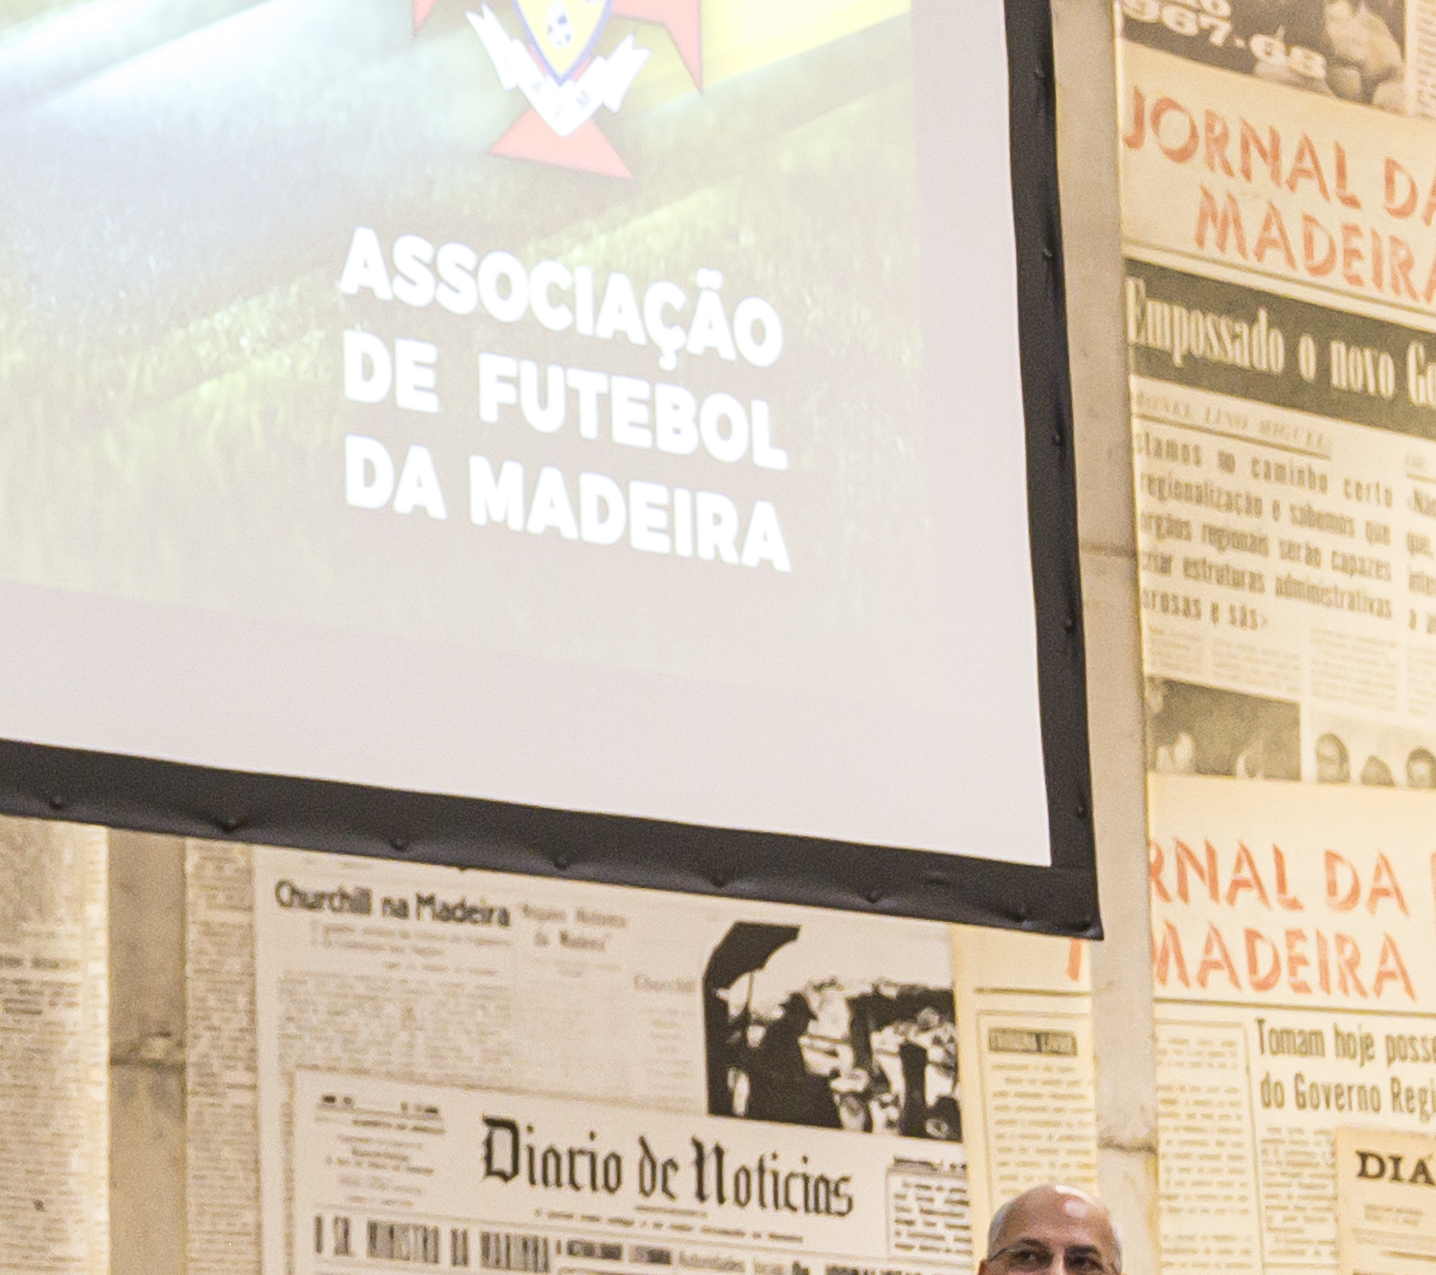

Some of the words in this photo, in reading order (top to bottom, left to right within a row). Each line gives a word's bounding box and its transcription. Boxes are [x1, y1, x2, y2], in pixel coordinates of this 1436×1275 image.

[1122, 85, 1362, 210] JORNAL
[339, 224, 785, 372] ASSOCIAÇÃO
[1125, 275, 1286, 375] Empossado
[1298, 334, 1317, 381] o
[1330, 341, 1396, 400] novo
[342, 328, 440, 414] DE
[476, 350, 790, 473] FUTEBOL
[344, 432, 448, 522] DA
[467, 453, 794, 575] MADEIRA
[275, 879, 373, 916] Churchill
[381, 896, 409, 919] na
[415, 891, 511, 929] Madeira
[1325, 849, 1410, 917] DA
[1255, 1018, 1325, 1058] Tomam
[1334, 1022, 1376, 1068] hoje
[1261, 1073, 1285, 1110] do
[1294, 1072, 1382, 1114] Governo
[480, 1114, 622, 1195] Diario
[637, 1135, 680, 1202] de
[691, 1134, 854, 1219] Noticias
